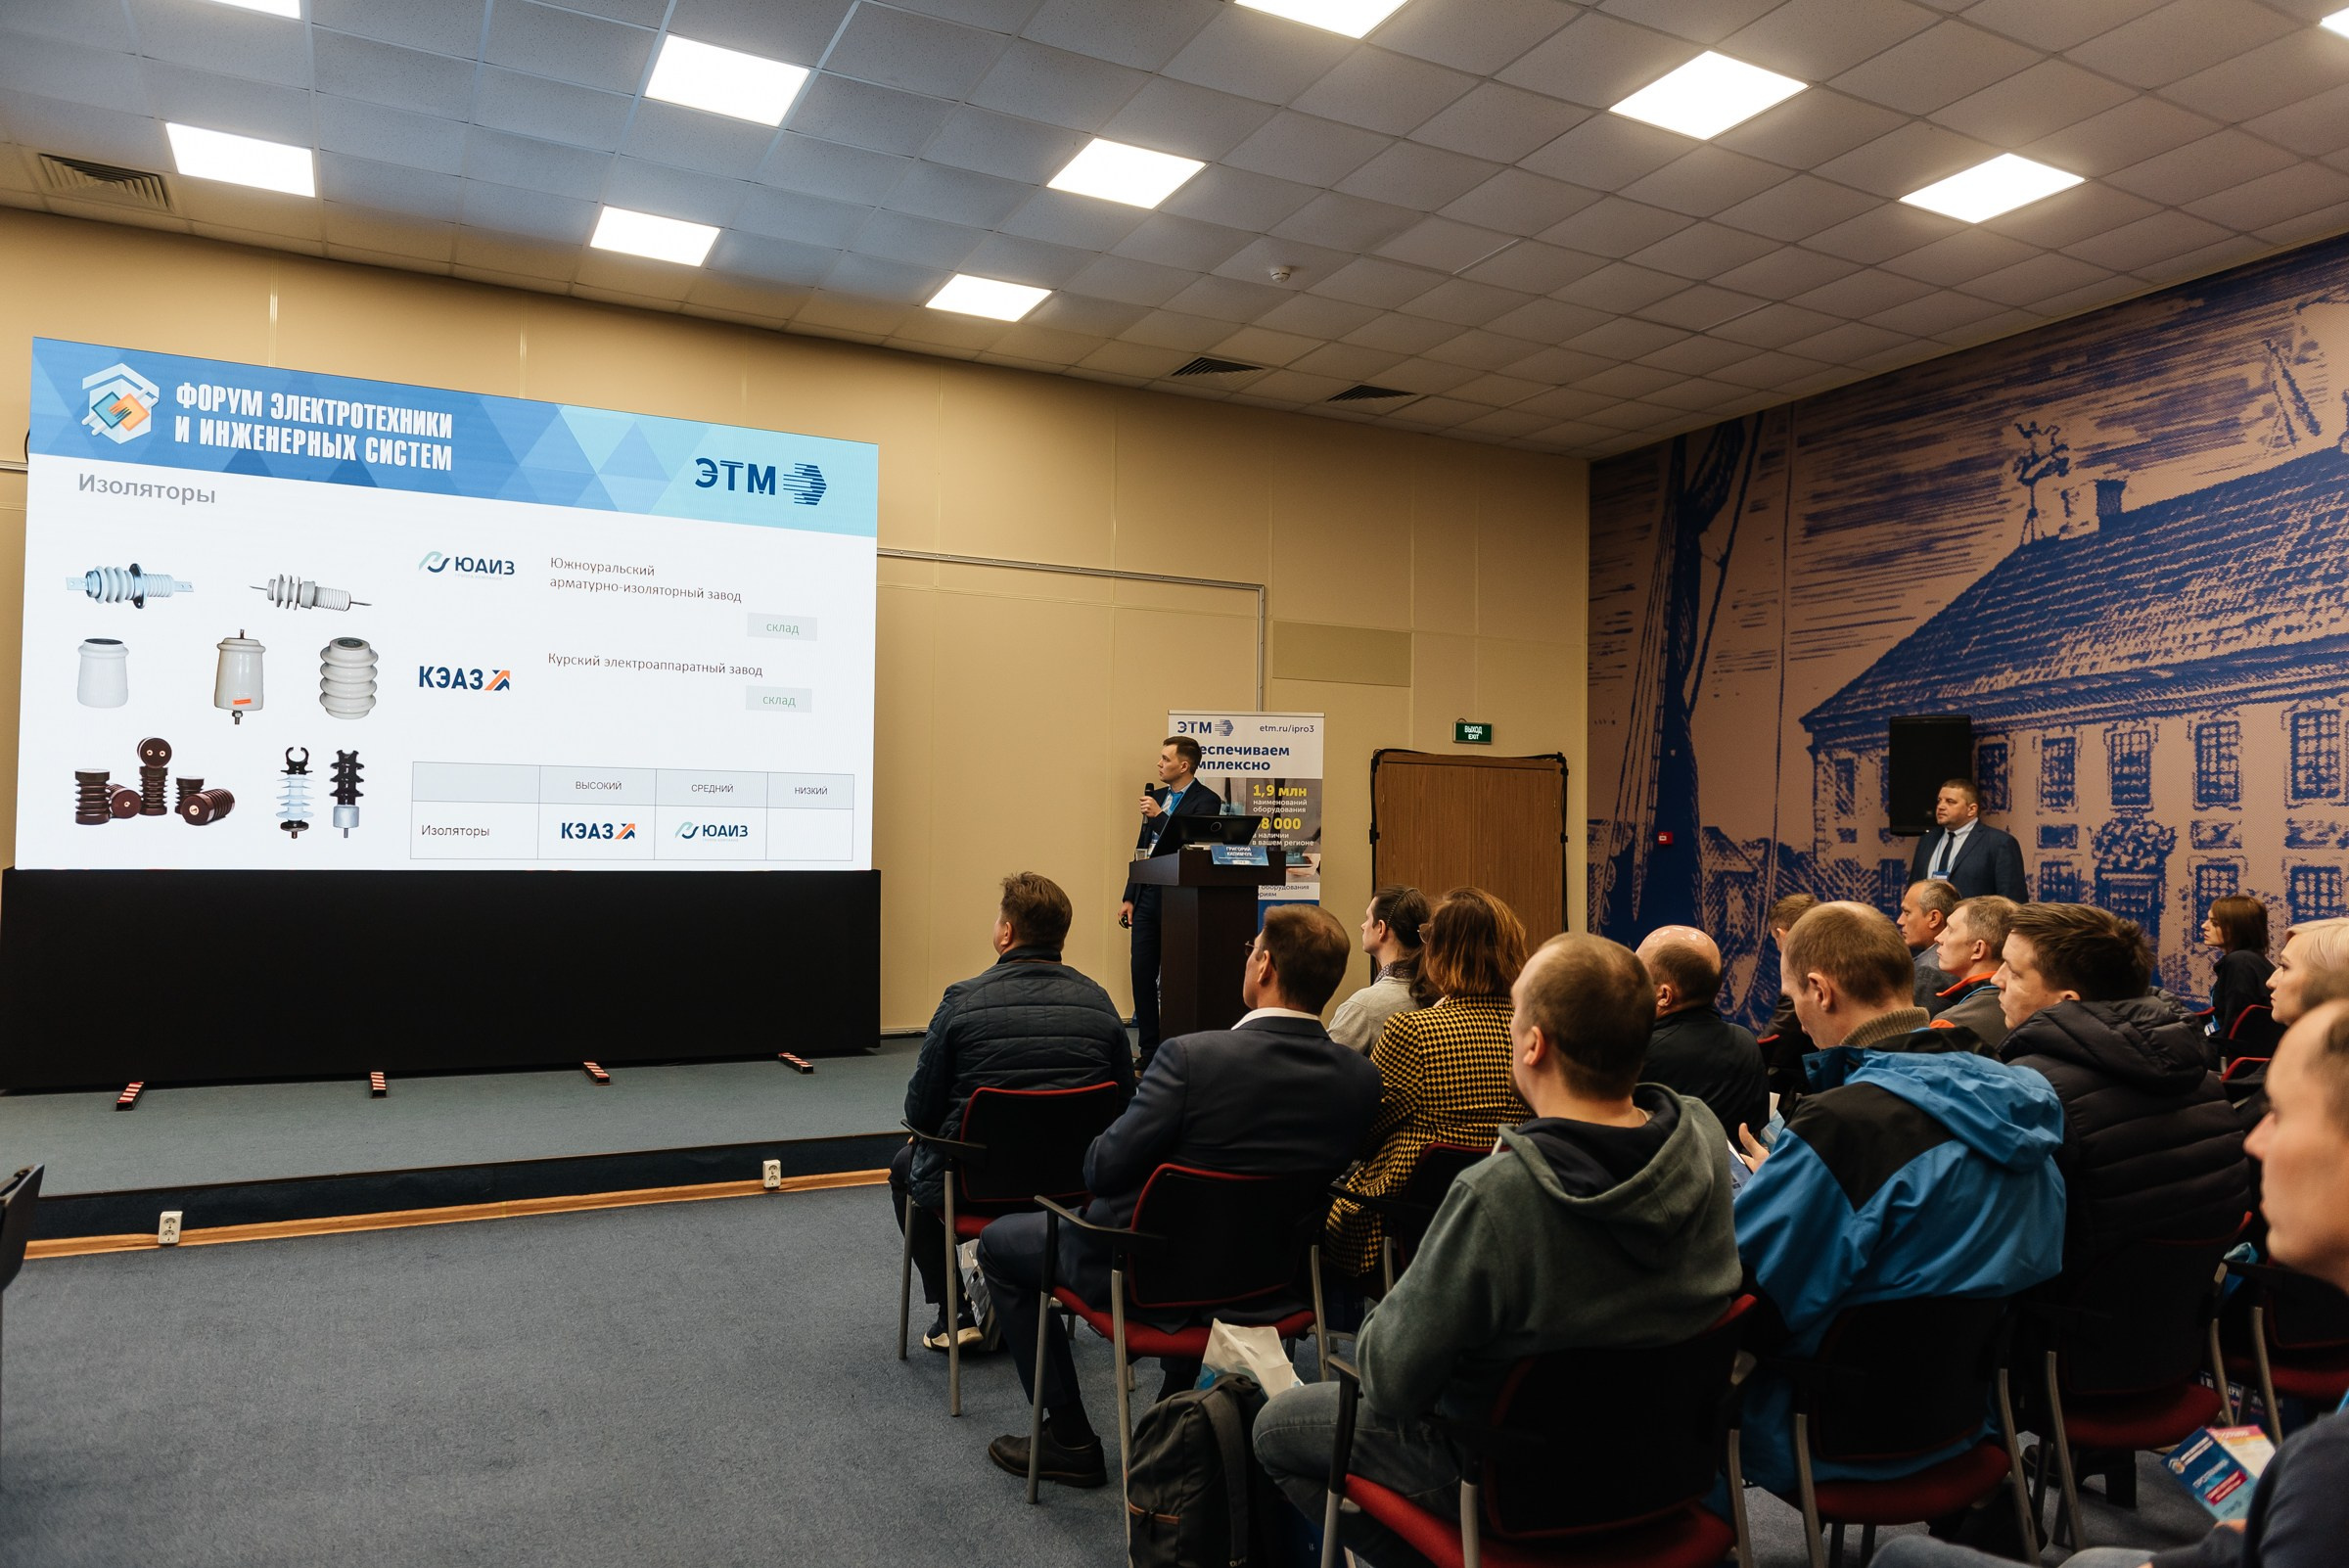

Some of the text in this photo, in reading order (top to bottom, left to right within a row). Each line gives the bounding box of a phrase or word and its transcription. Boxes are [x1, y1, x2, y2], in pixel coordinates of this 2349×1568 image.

[176, 382, 453, 439] ФОРУМ ЭЛЕКТРОТЕХНИКИ
[174, 415, 453, 472] И ИНЖЕНЕРНЫХ СИСТЕМ
[695, 457, 776, 496] ЭТМ
[78, 473, 216, 505] Изоляторы
[455, 556, 515, 576] ЮАИЗ
[550, 557, 656, 577] Южноуральский
[549, 578, 742, 604] арматурно-изоляторный завод
[765, 621, 800, 636] склад
[548, 652, 763, 678] Курский электроаппаратный завод
[419, 666, 484, 691] КЭАЗ
[762, 693, 797, 709] склад
[1177, 720, 1213, 734] ЭТМ
[1260, 725, 1314, 734] etm.ru/ipro3
[1464, 725, 1482, 735] ВЫХОД
[1200, 745, 1290, 757] еспечиваем
[1197, 761, 1270, 770] мплексно
[575, 779, 622, 791] ВЫСОКИЙ
[691, 782, 734, 795] СРЕДНИЙ
[794, 785, 828, 796] НИЗКИЙ
[1278, 787, 1308, 797] млн
[1253, 806, 1307, 814] оборудования
[421, 823, 490, 839] Изоляторы
[561, 822, 615, 840] КЭАЗ
[702, 821, 749, 839] ЮАИЗ
[1259, 817, 1302, 830] 8 000
